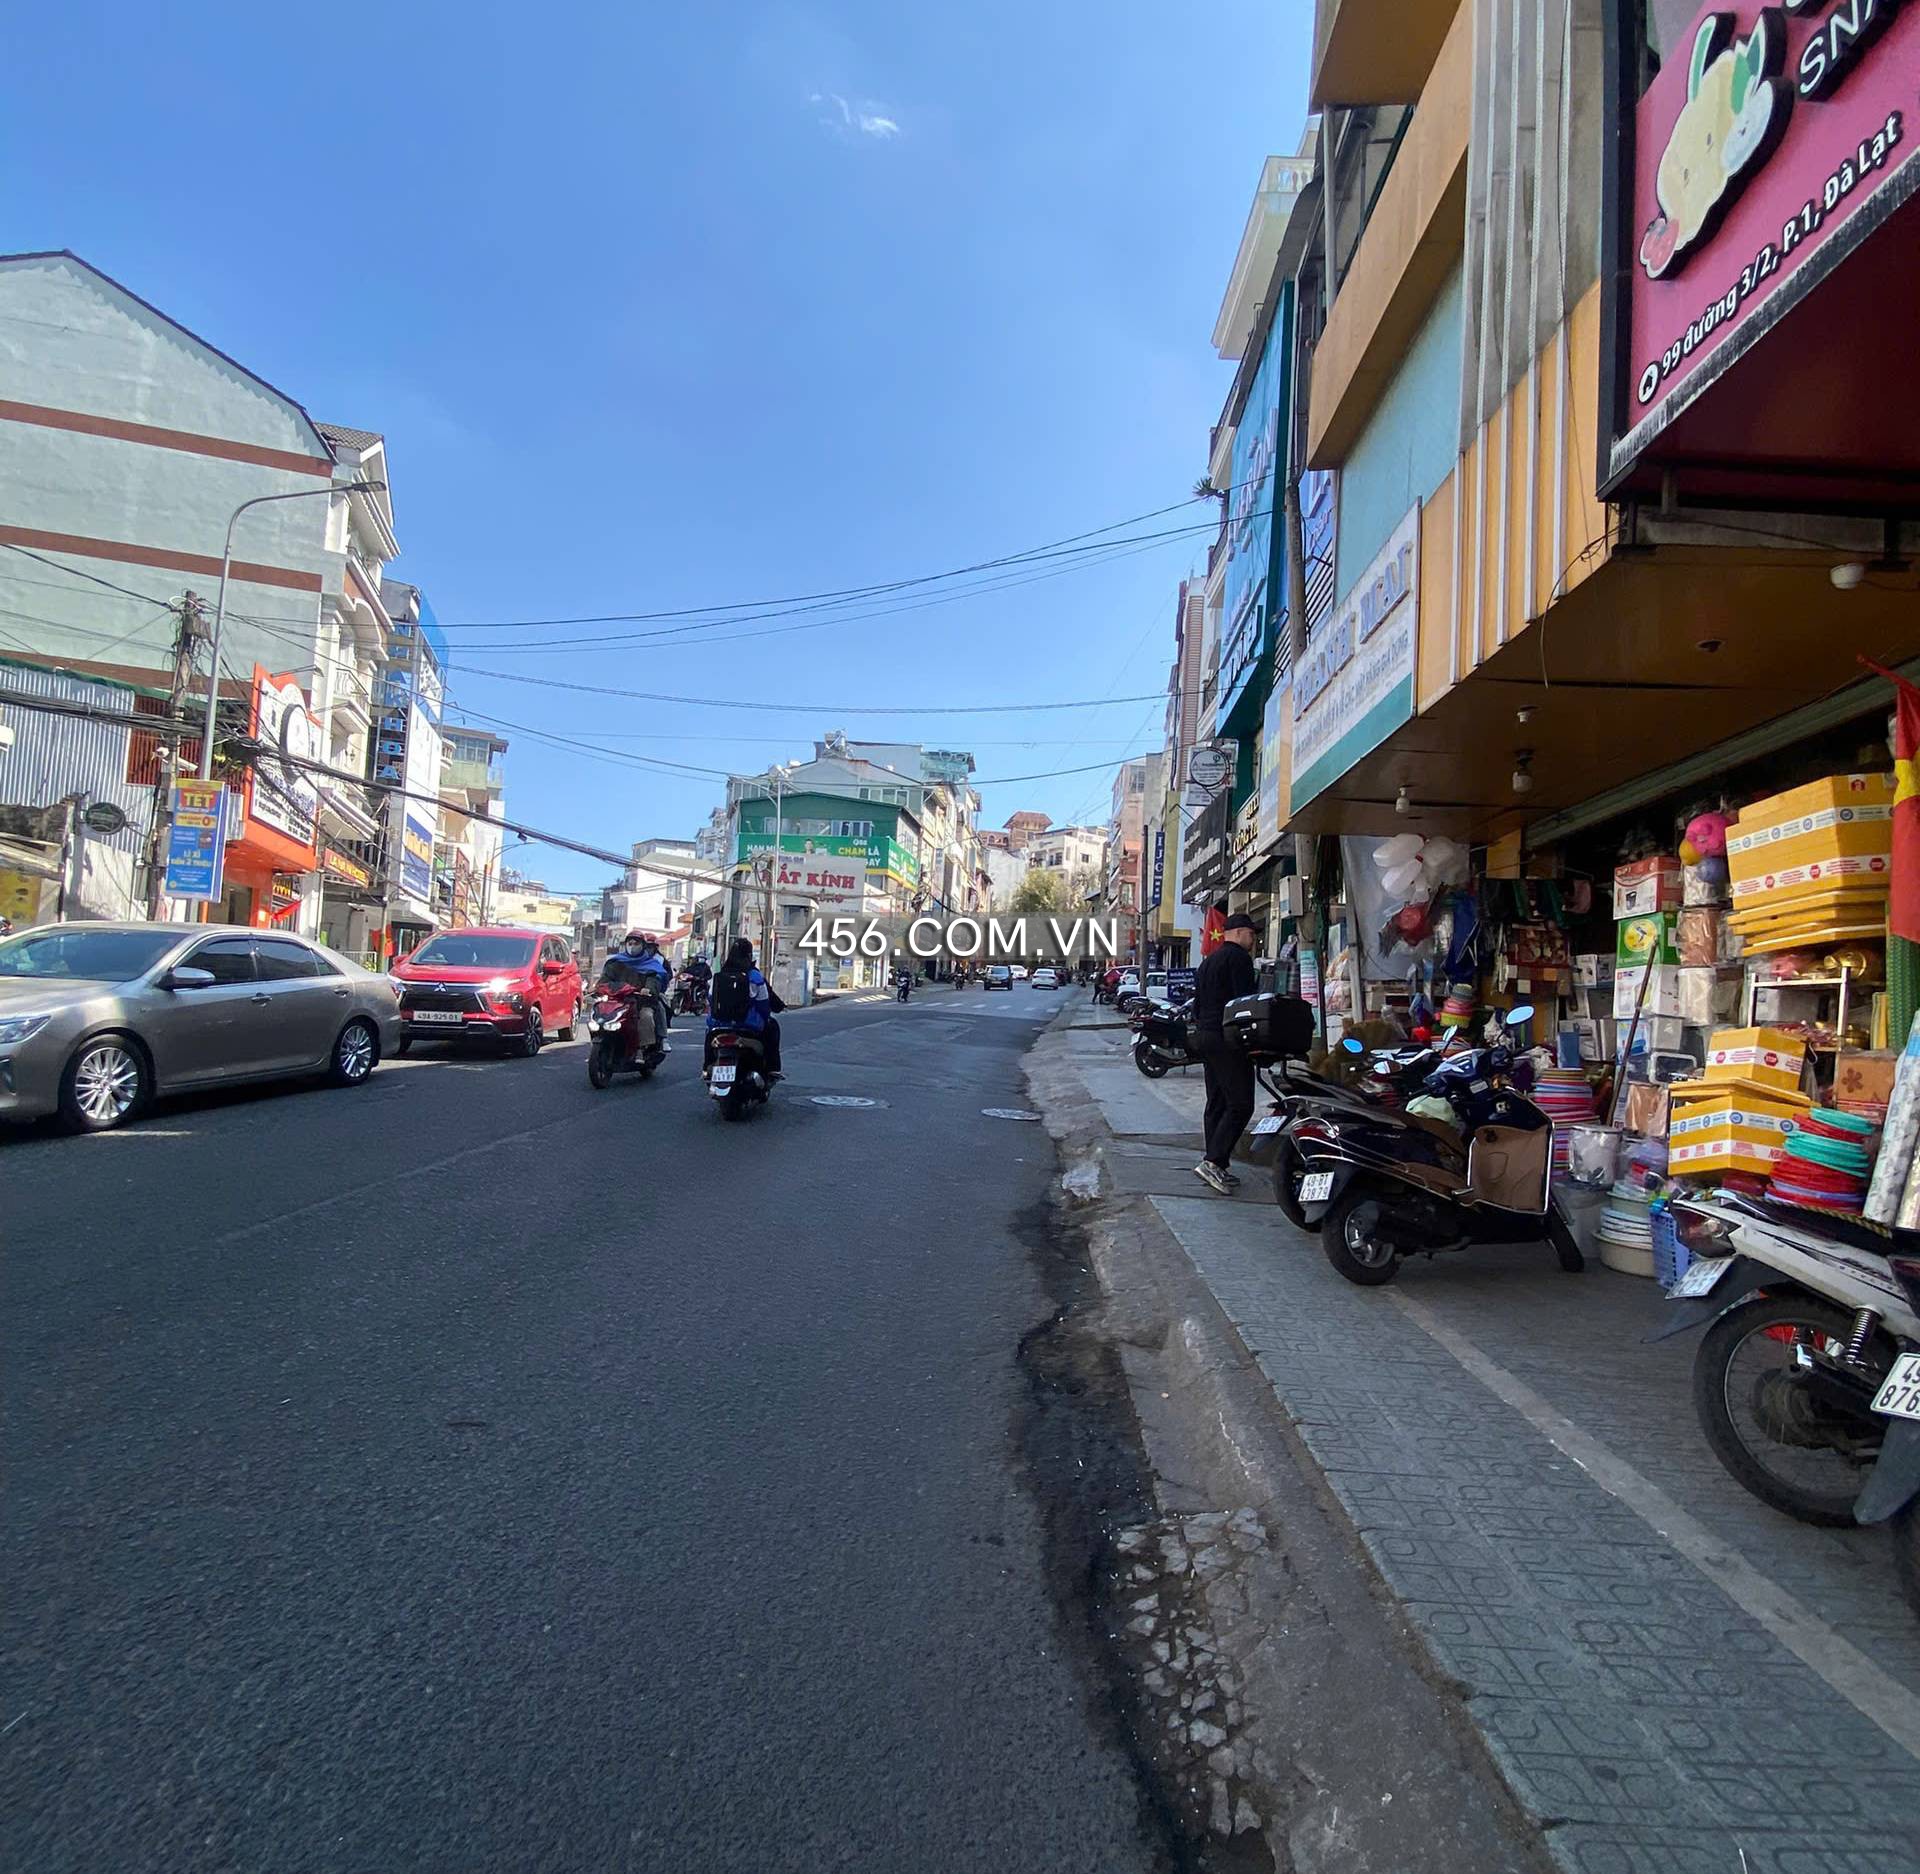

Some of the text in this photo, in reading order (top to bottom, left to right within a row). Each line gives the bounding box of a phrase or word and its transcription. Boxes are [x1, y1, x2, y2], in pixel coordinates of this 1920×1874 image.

[1662, 341, 1680, 377] 99
[1683, 287, 1738, 351] đường
[1741, 246, 1779, 296] 3/2,
[1824, 163, 1854, 209] Đà
[1859, 115, 1898, 171] Lạt
[806, 869, 856, 890] KÍNH
